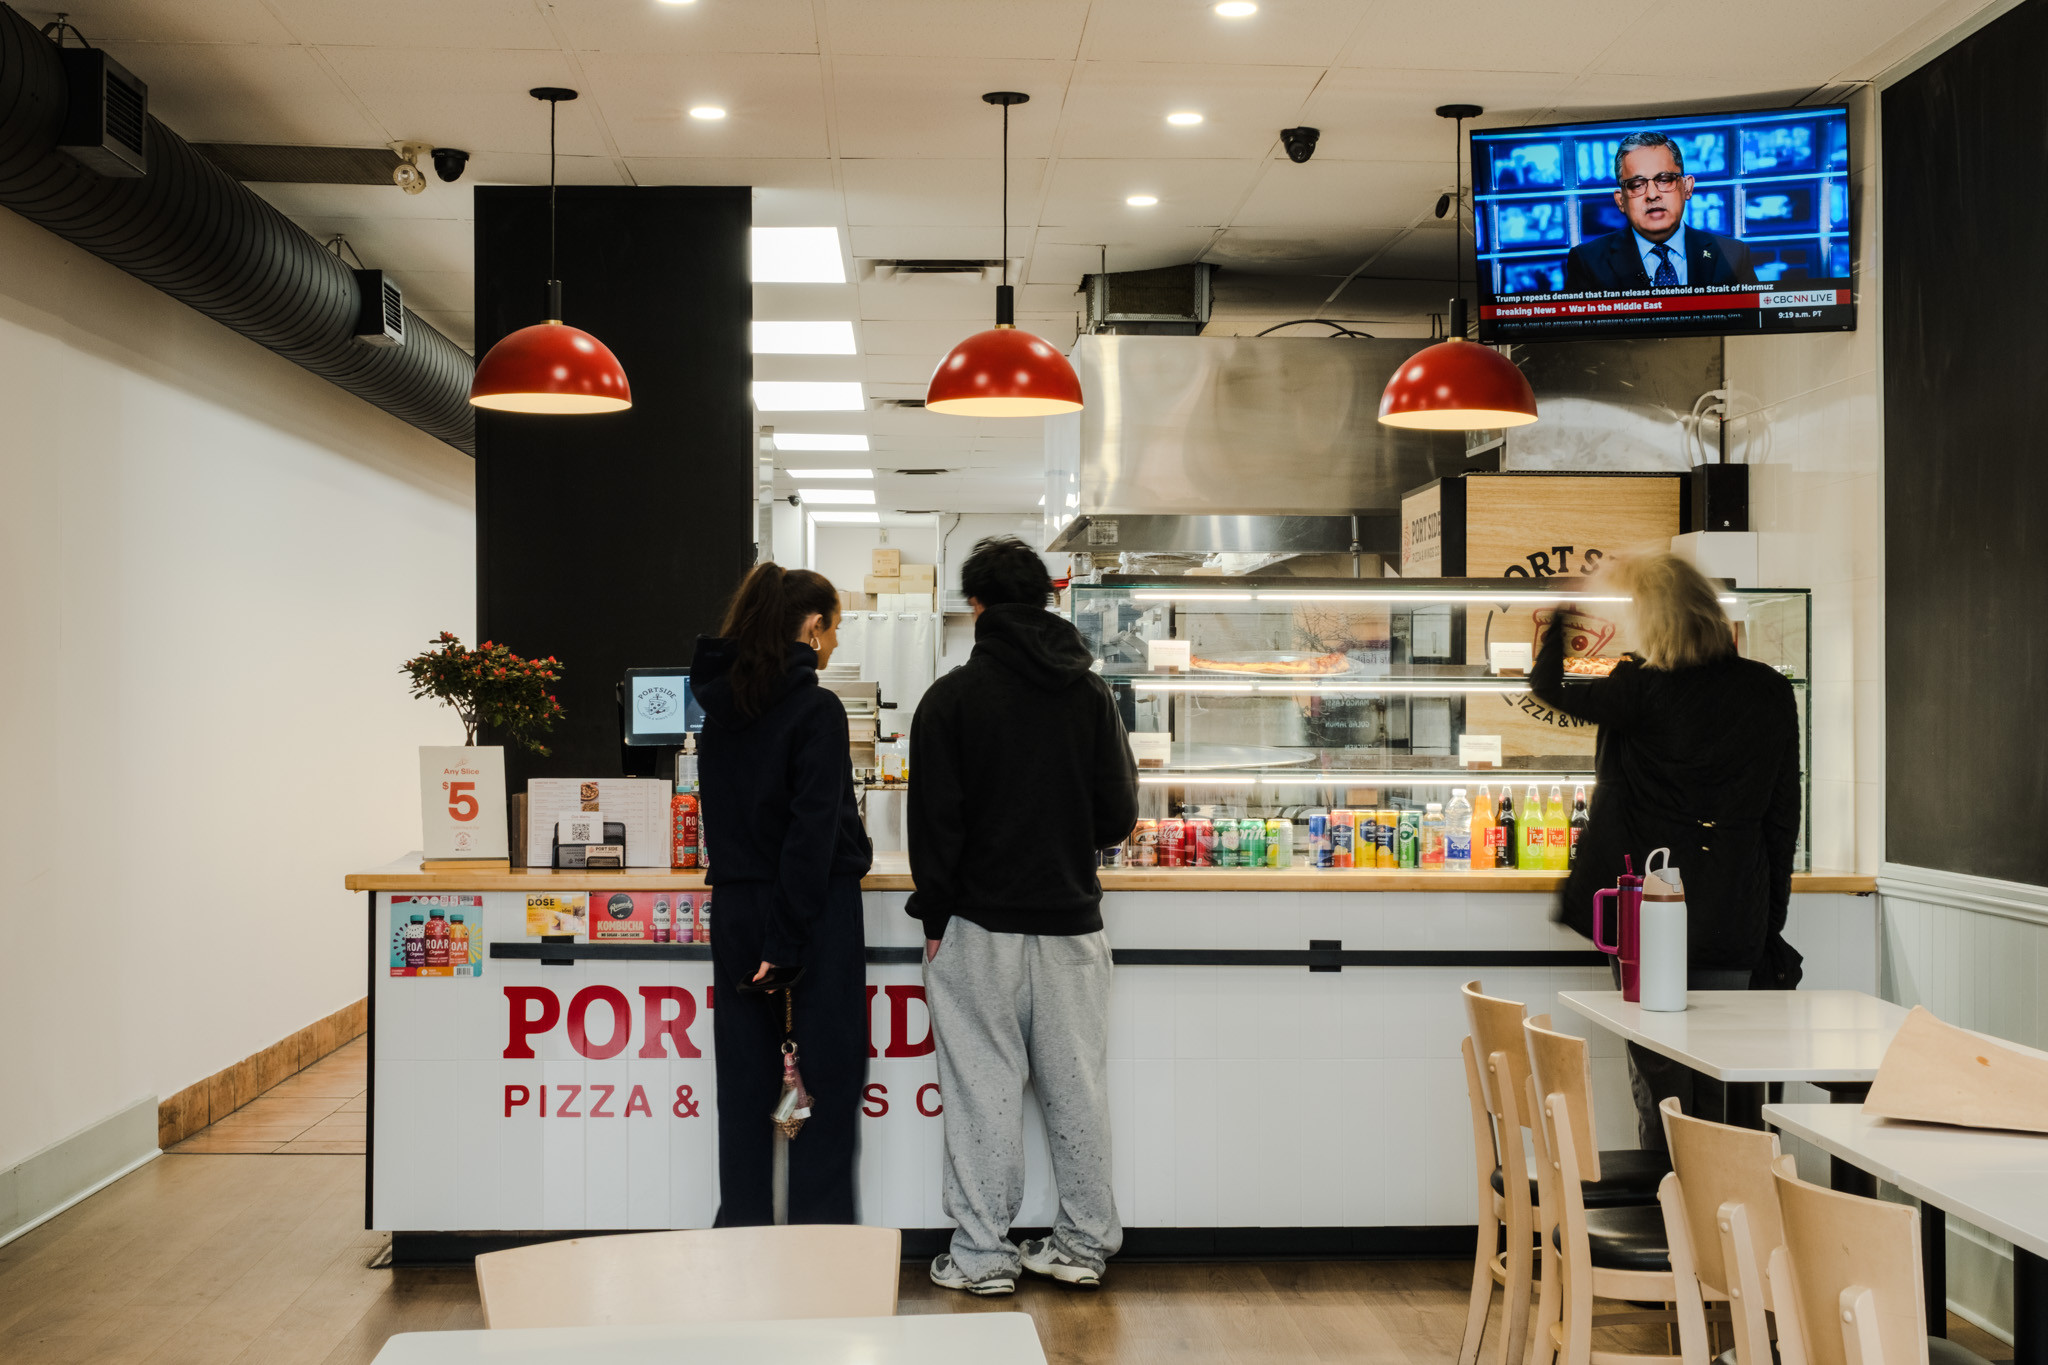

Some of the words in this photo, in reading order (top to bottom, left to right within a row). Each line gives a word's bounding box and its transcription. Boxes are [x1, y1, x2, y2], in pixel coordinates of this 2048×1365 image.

[1496, 296, 1521, 304] Trump
[1651, 287, 1692, 296] chokehold
[1706, 285, 1729, 293] Strait
[1773, 294, 1808, 304] CBCNN
[1811, 294, 1833, 302] LIVE
[1496, 308, 1532, 316] Breaking
[1534, 306, 1556, 314] News
[1613, 302, 1642, 311] Middle
[1412, 516, 1427, 546] PORT
[1428, 510, 1440, 540] SIDE
[638, 687, 676, 700] PORTSIDE
[1558, 714, 1569, 728] &
[597, 921, 644, 931] KOMBUCHA
[407, 942, 422, 951] ROA
[426, 939, 449, 949] ROAR
[451, 942, 467, 950] OAR
[503, 985, 714, 1060] POR
[504, 1084, 653, 1118] PIZZA
[672, 1084, 700, 1118] &
